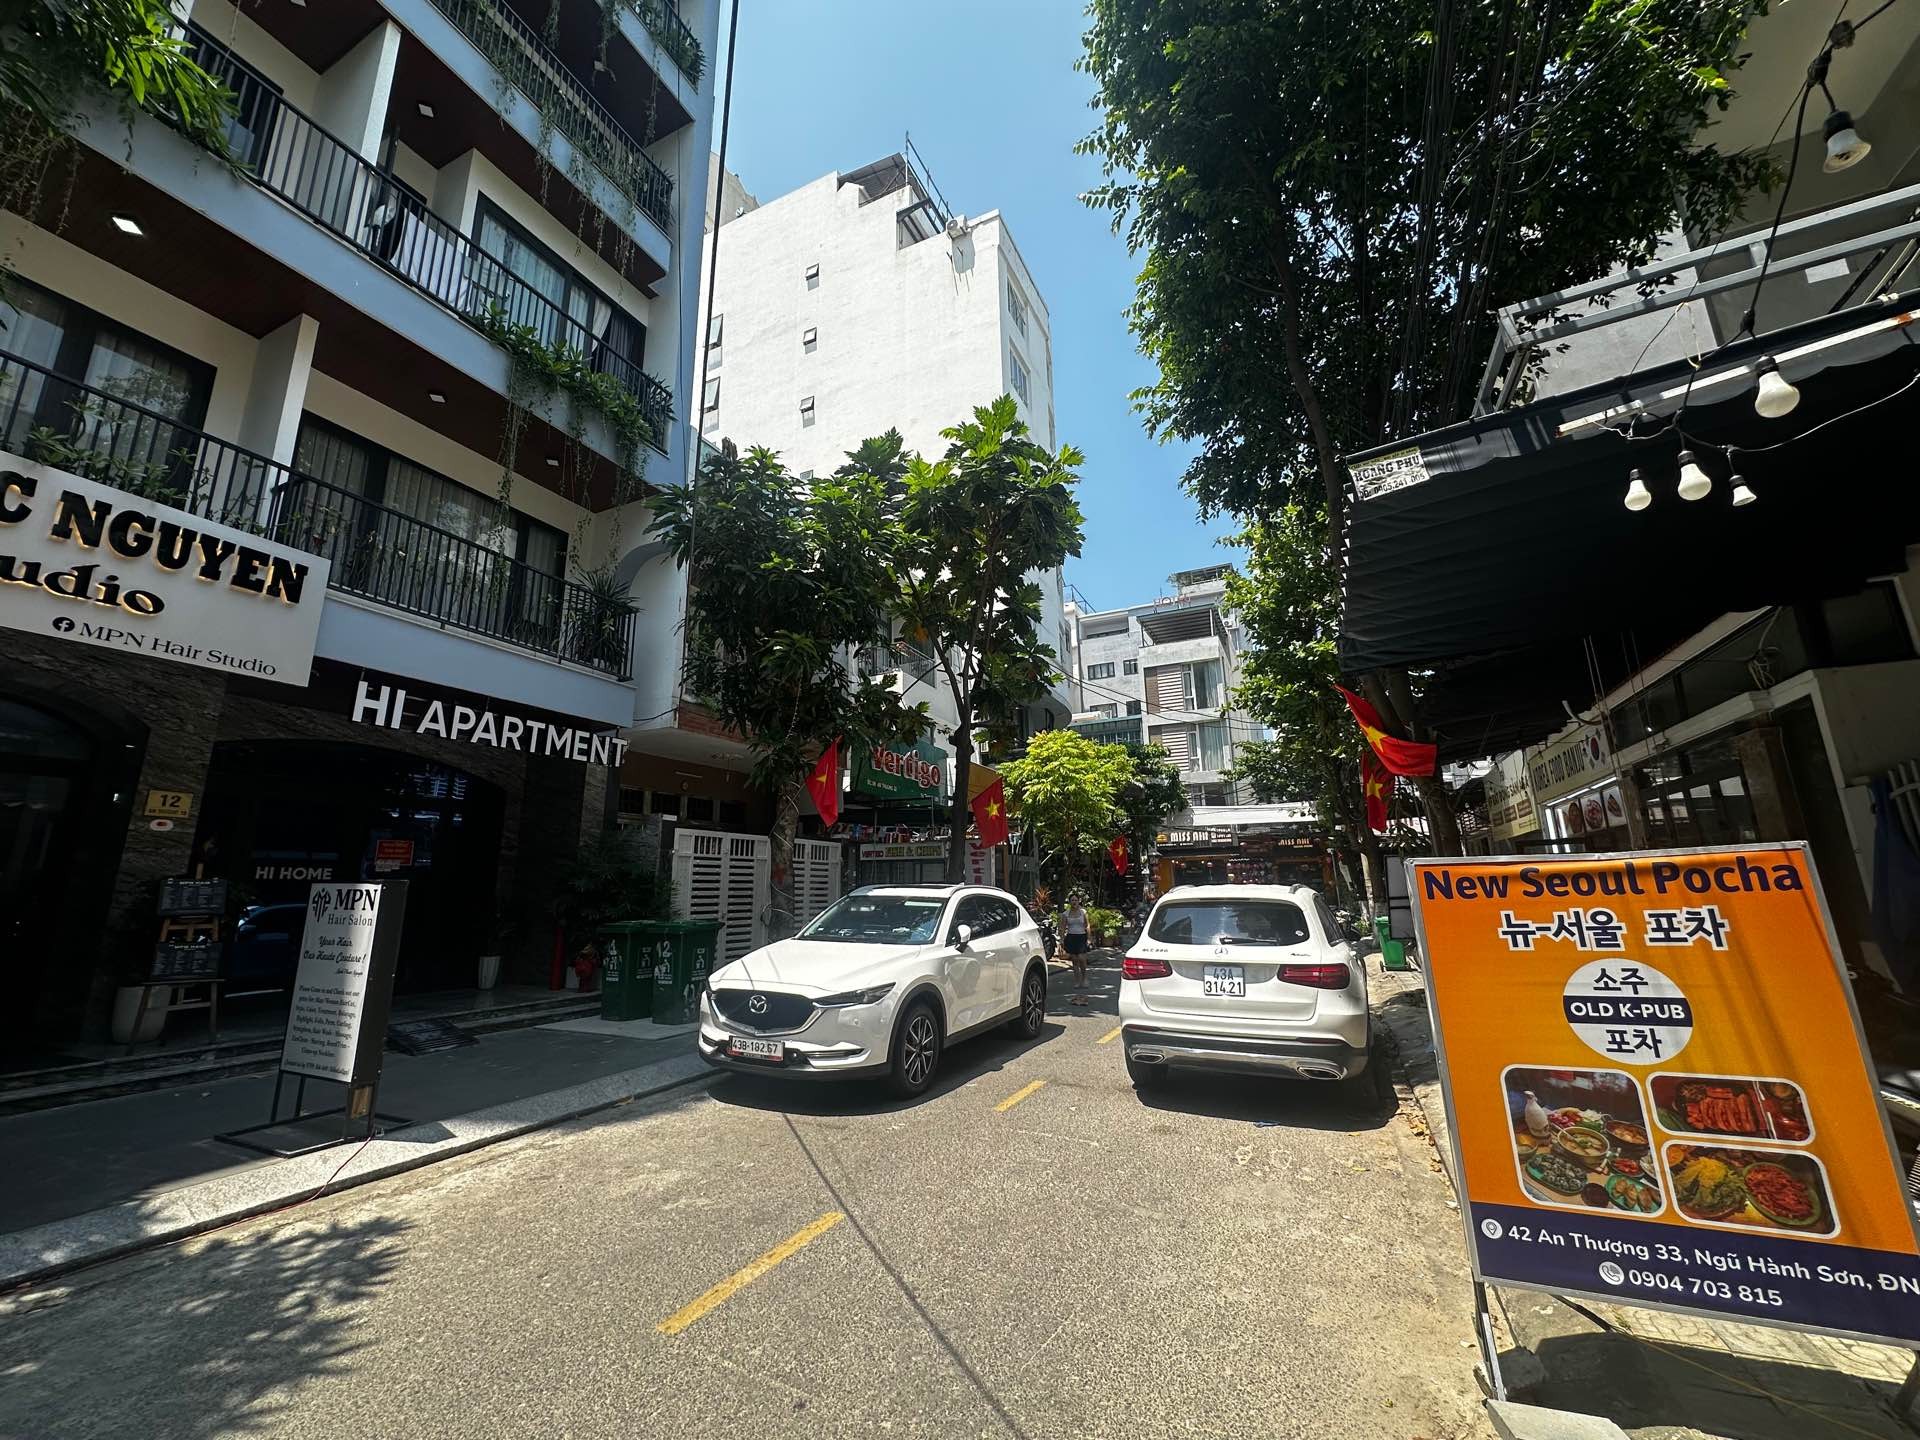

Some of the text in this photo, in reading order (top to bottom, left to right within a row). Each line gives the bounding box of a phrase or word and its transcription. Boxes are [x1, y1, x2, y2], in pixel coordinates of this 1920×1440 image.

[50, 490, 309, 604] NGUYEN
[79, 622, 277, 676] MPN Hair Studio
[352, 680, 628, 767] HI APARTMENT
[872, 746, 942, 788] Vertigo
[160, 794, 182, 808] 12
[1170, 831, 1191, 842] MISS
[255, 866, 333, 880] HI HOME
[1423, 856, 1803, 900] New Seoul Pocha
[334, 888, 378, 911] MPN
[327, 914, 373, 926] Hair Salon
[1500, 906, 1727, 949] 뉴-서울 포차
[1205, 981, 1242, 994] 314.21
[1213, 968, 1233, 980] 43A
[1593, 968, 1648, 995] 소주
[1570, 1001, 1685, 1020] OLD K-PUB
[732, 1038, 778, 1054] 43B-182.67
[1606, 1028, 1662, 1058] 포차
[1508, 1225, 1920, 1295] 42 An Thượng 33, Ngũ Hành Sơn, ĐN
[1628, 1269, 1783, 1306] 0904 703 815
